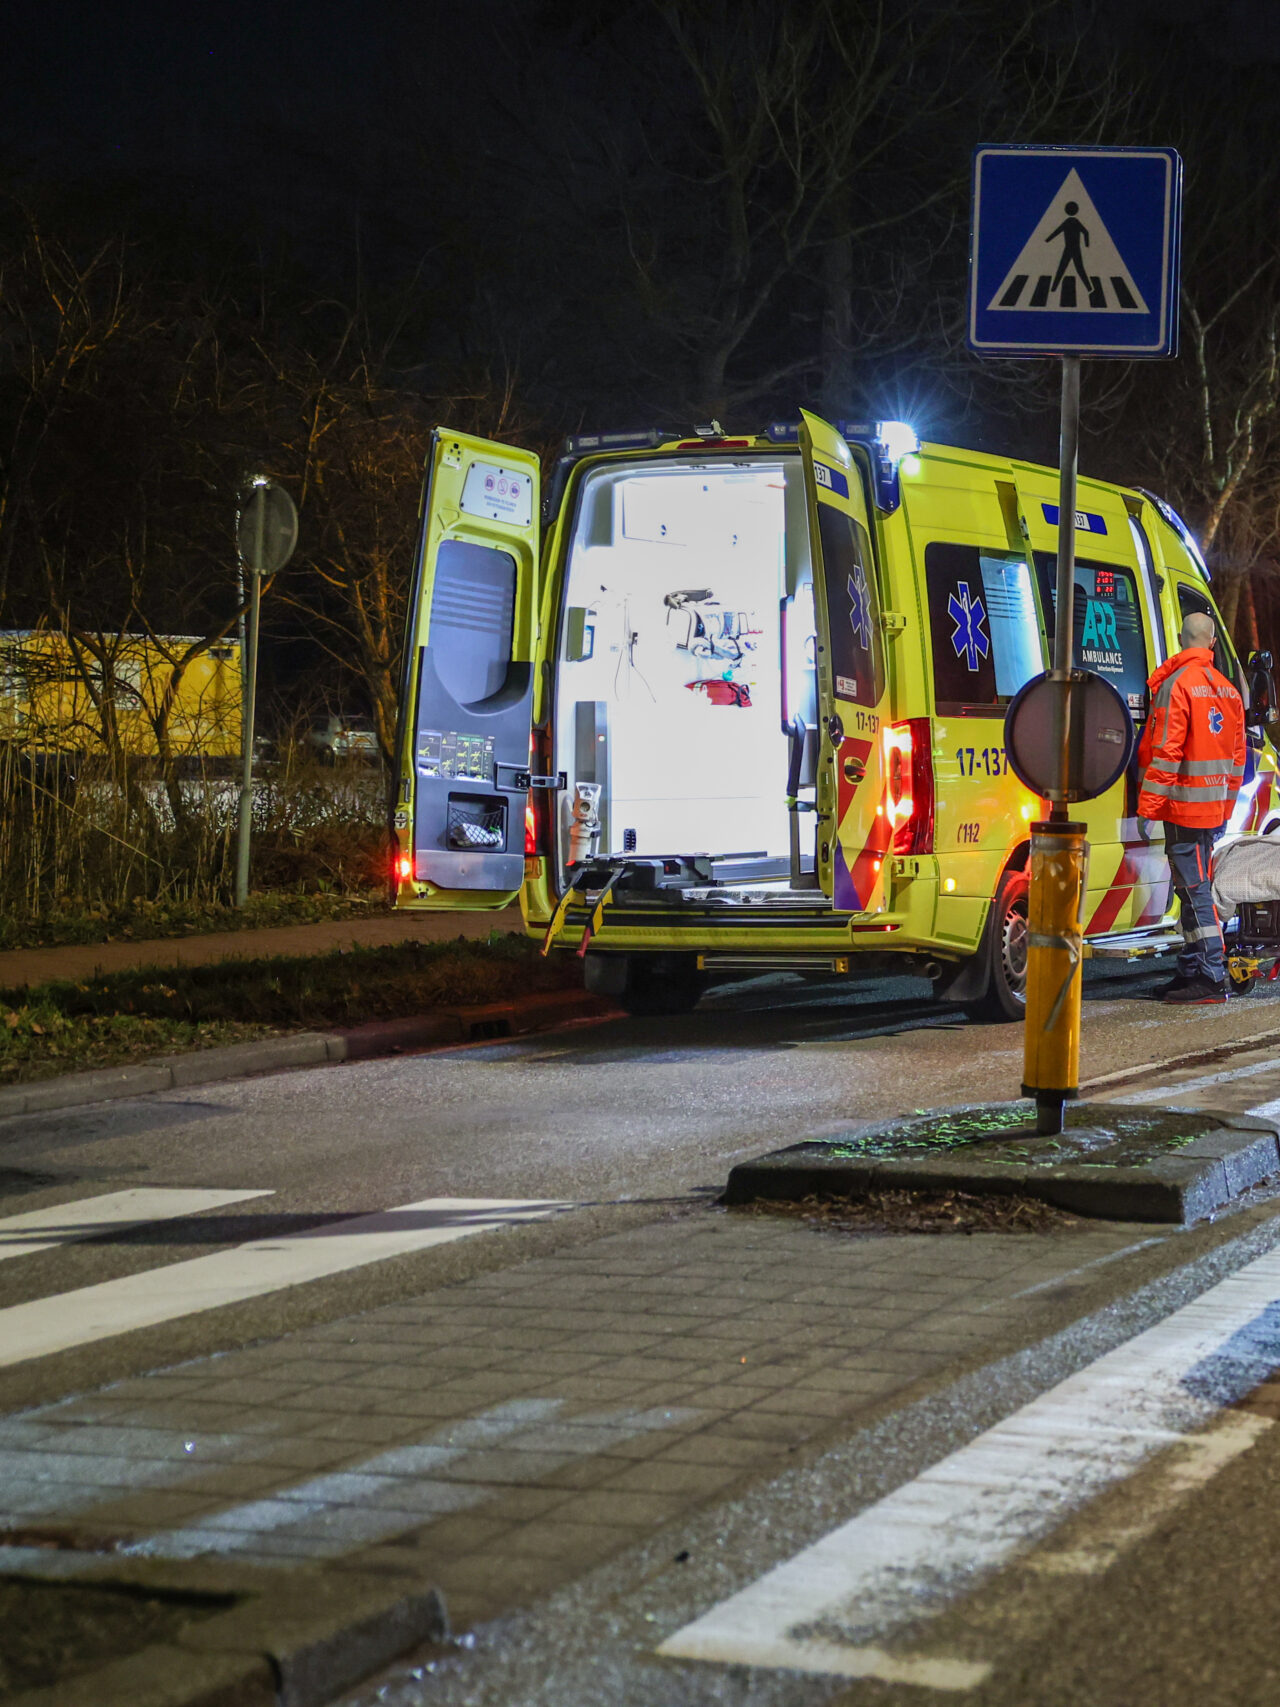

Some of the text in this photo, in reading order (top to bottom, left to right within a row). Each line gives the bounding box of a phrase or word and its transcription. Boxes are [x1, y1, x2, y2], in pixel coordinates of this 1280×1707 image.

[1082, 649, 1123, 665] AMBULANCE
[856, 711, 880, 735] 17-137
[956, 747, 1008, 776] 17-137
